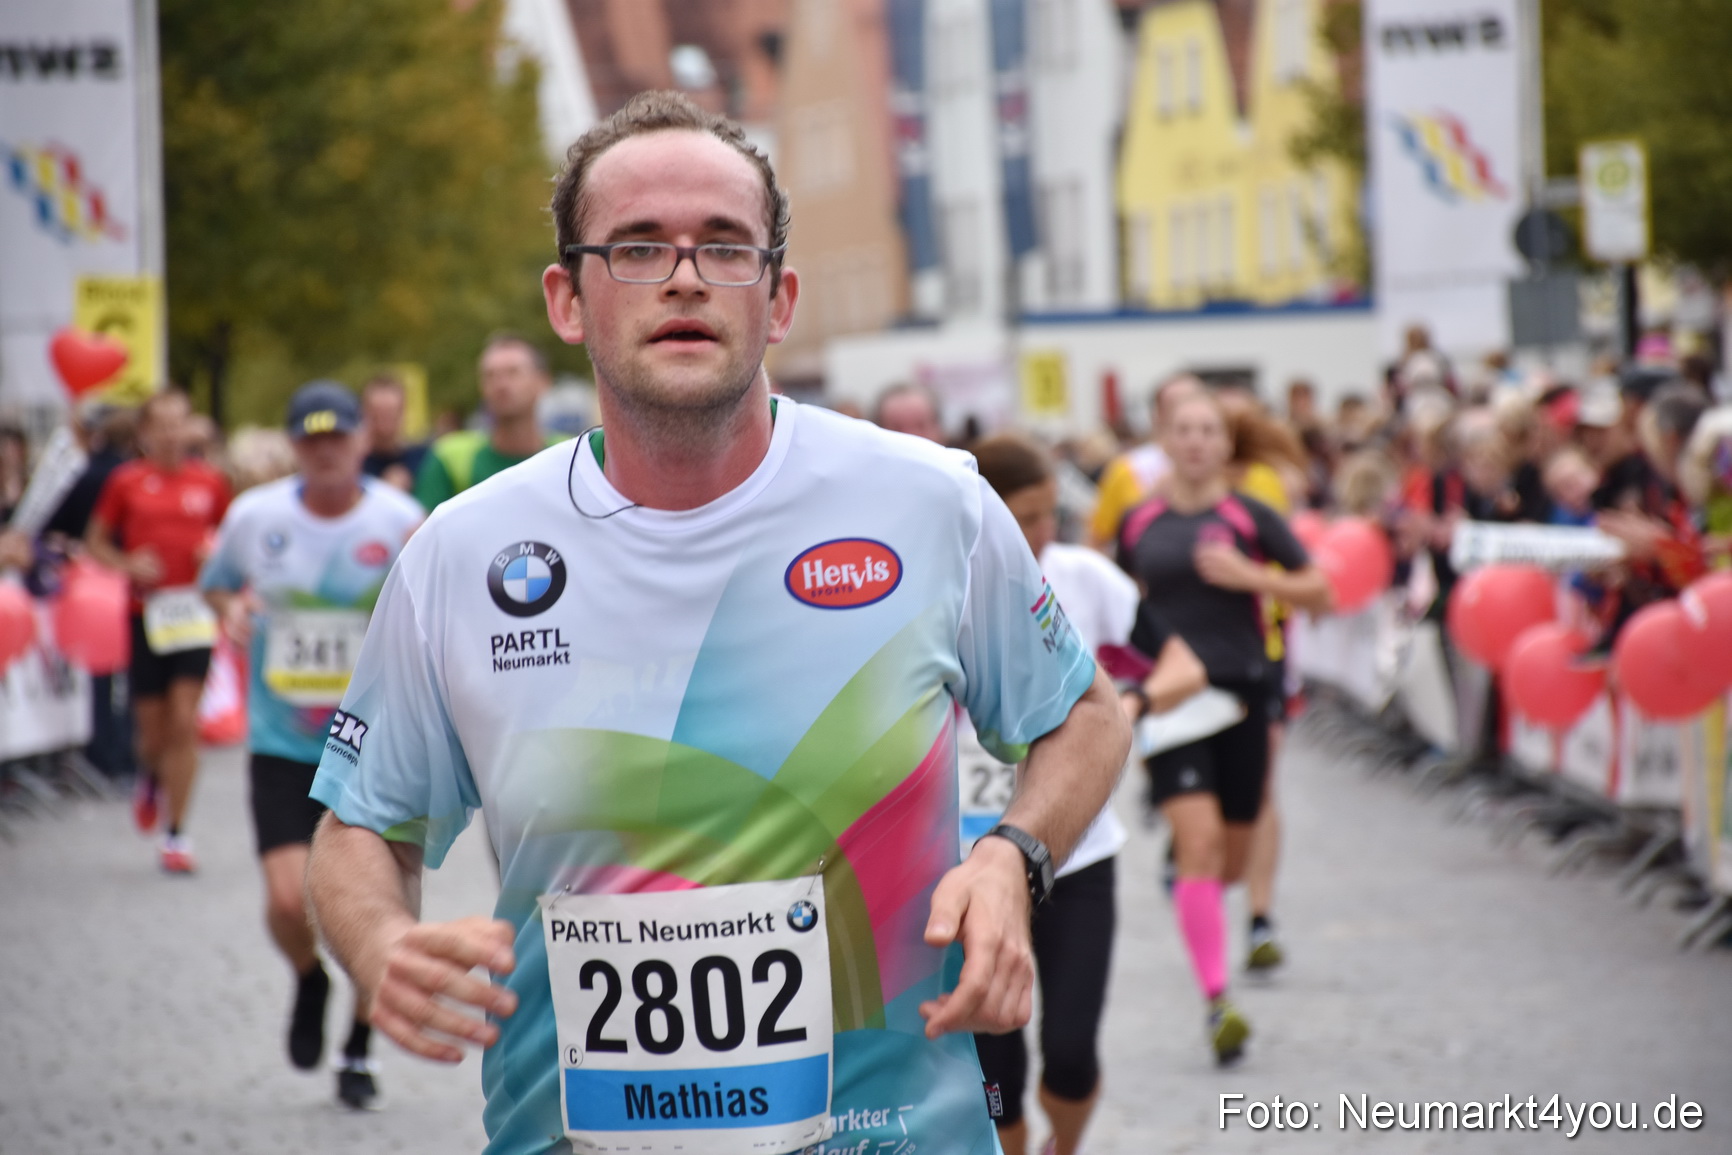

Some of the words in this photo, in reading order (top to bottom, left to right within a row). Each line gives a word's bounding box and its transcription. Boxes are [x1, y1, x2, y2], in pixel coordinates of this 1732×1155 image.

[495, 542, 560, 568] BMW
[802, 556, 890, 590] Hervis
[811, 585, 853, 598] SPORTS
[491, 627, 570, 656] PARTL
[493, 651, 571, 673] Neumarkt
[551, 920, 632, 944] PARTL
[639, 912, 775, 943] Neumarkt
[579, 948, 807, 1055] 2802
[624, 1082, 769, 1120] Mathias
